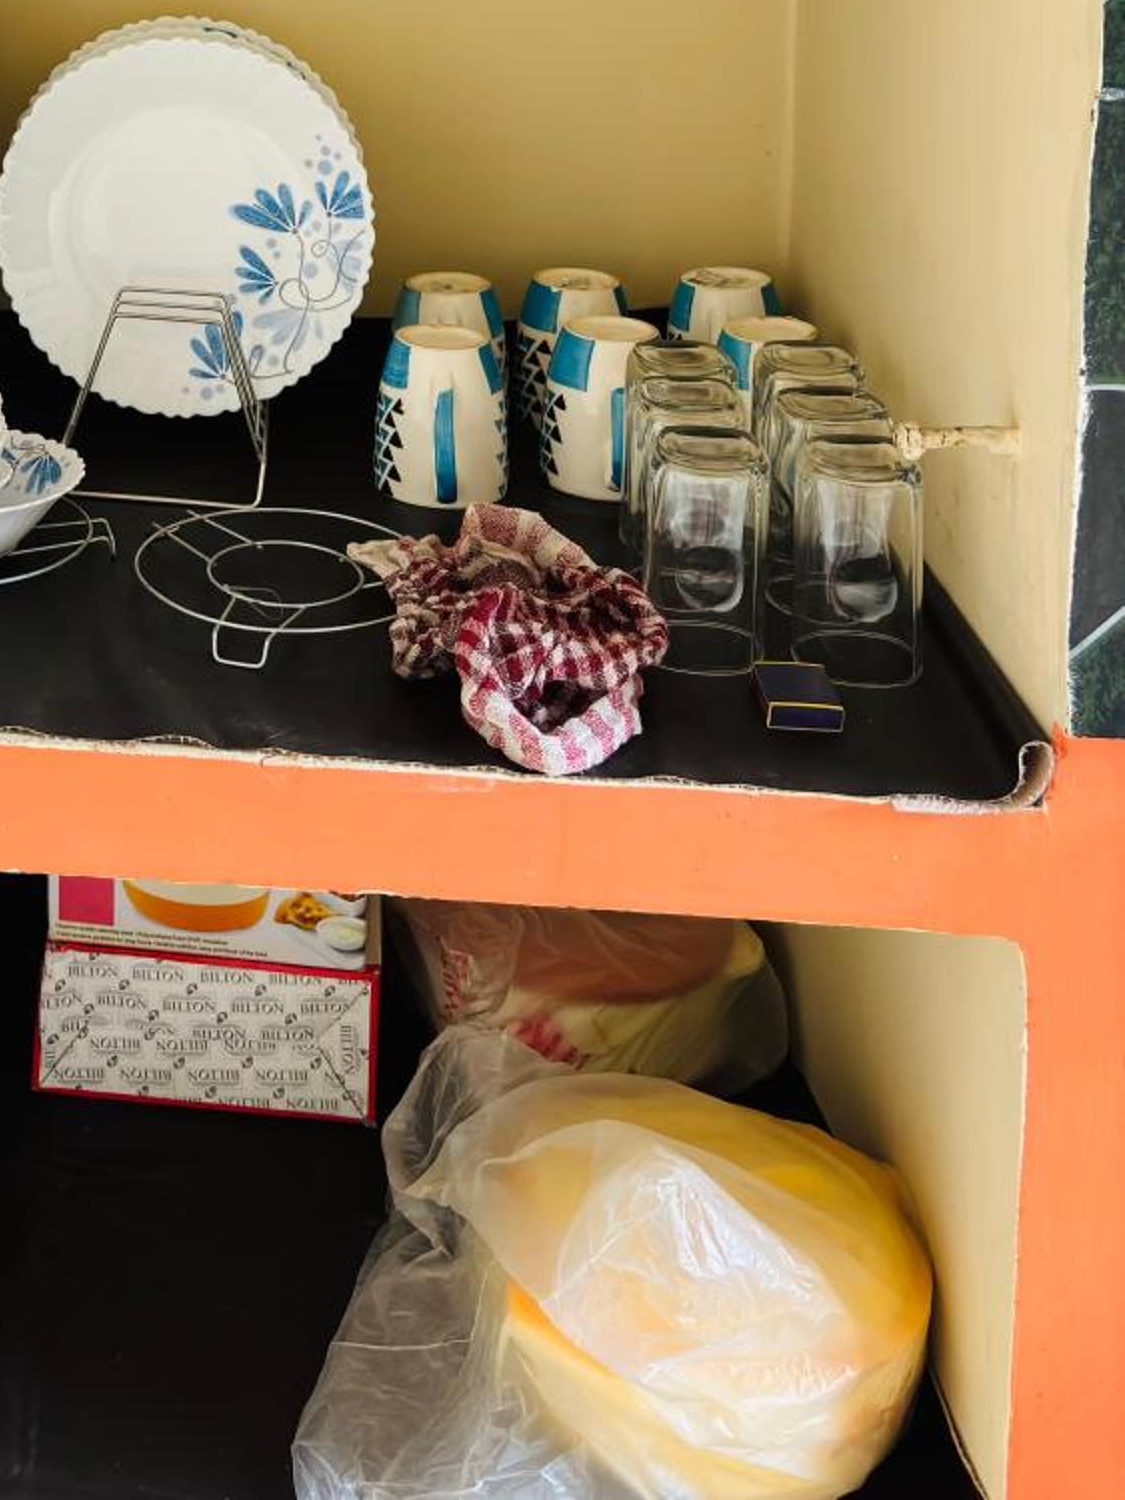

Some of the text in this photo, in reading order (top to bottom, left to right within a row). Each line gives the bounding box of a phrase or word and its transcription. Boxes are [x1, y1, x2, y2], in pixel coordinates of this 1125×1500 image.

[67, 966, 119, 978] BILTON
[132, 968, 184, 981] BILTON
[200, 971, 252, 983] BILTON
[97, 996, 147, 1009] BILTON
[162, 1001, 216, 1013] BILTON
[231, 1002, 284, 1014] BILTON
[300, 1003, 350, 1013] BILTON
[192, 1028, 246, 1041] BILTON
[261, 1029, 314, 1041] BILTON
[90, 1037, 141, 1049] BILTON
[156, 1039, 209, 1051] BILTON
[54, 1067, 308, 1081] BILTON BILTON BILTON BILTON
